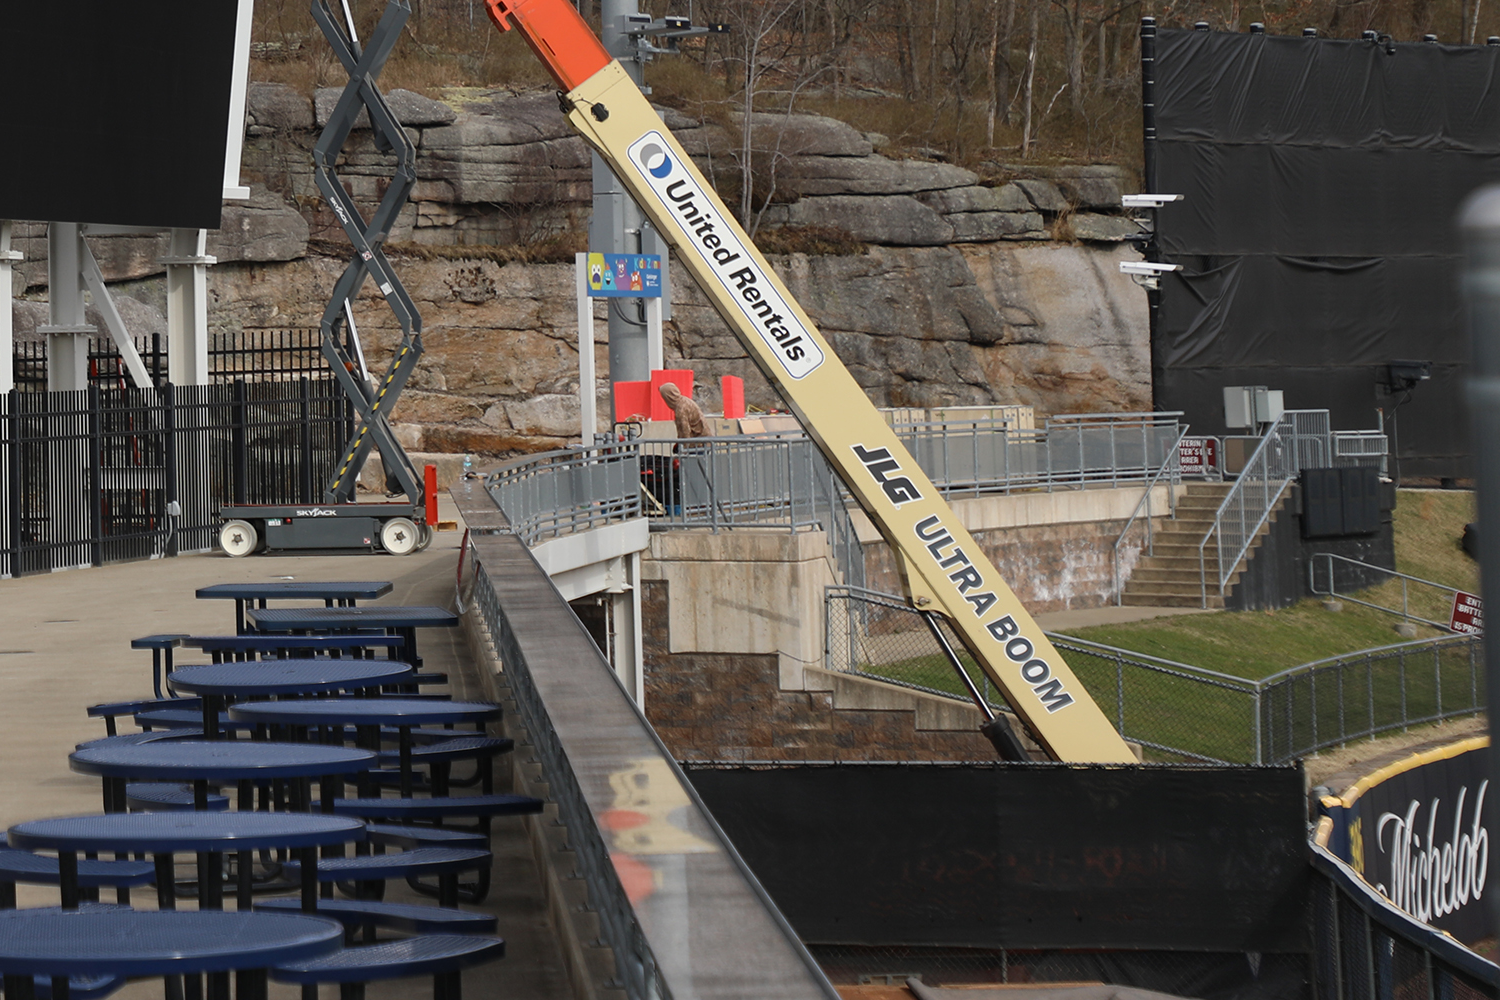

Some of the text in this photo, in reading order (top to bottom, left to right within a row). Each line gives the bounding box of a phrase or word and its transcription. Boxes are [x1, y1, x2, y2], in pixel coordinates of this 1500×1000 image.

[330, 196, 349, 225] SKYJACK
[666, 179, 806, 363] United Rentals
[296, 507, 337, 517] SKYJACK
[850, 443, 1076, 714] JLG ULTRA BOOM
[1376, 779, 1490, 925] Michelob
